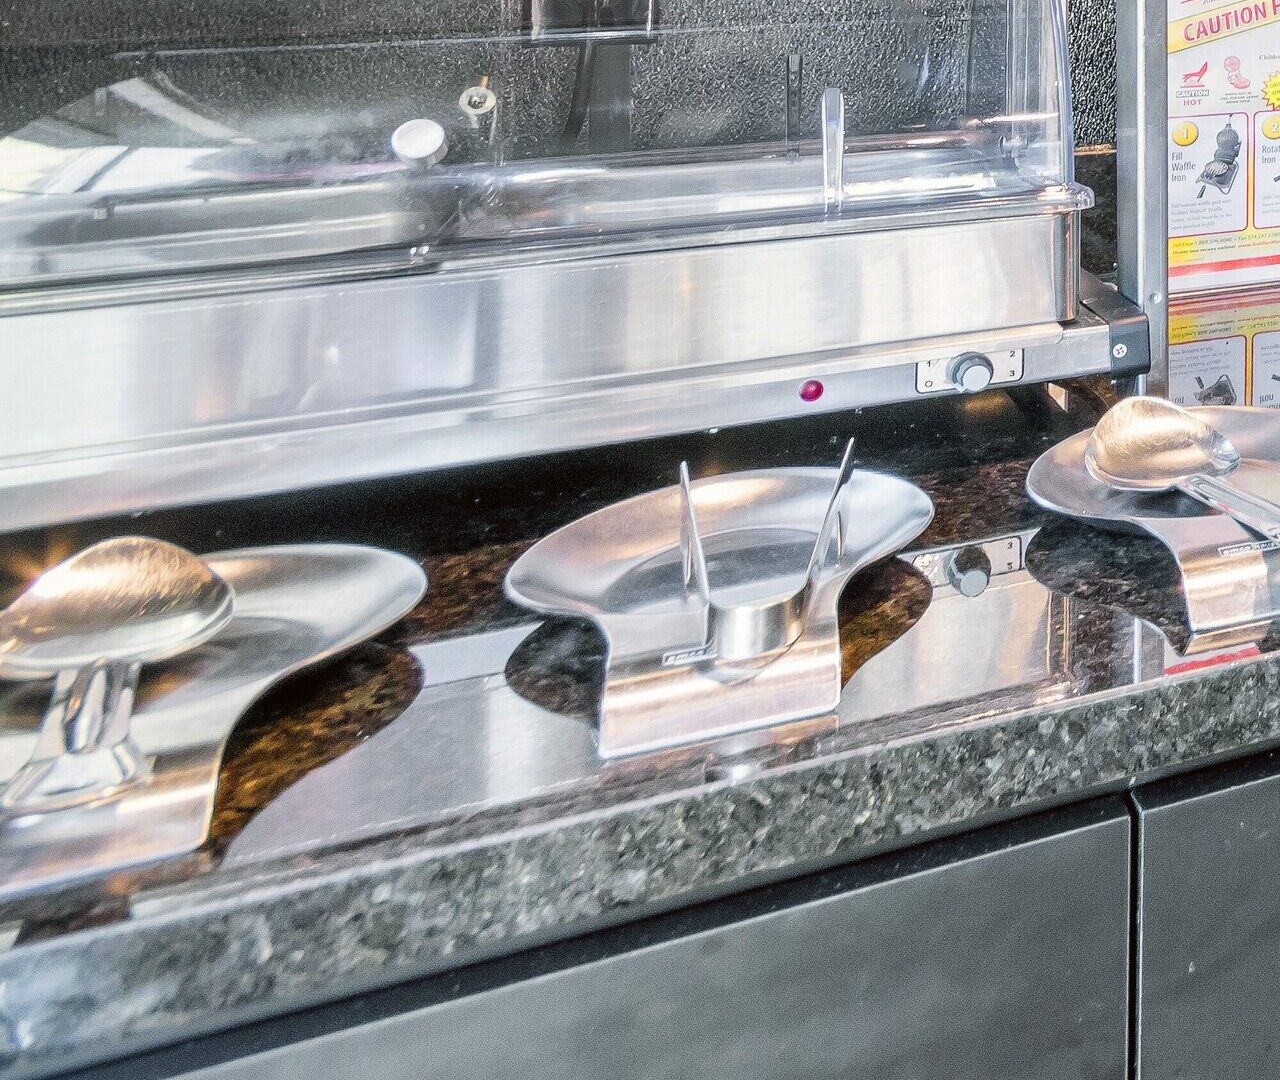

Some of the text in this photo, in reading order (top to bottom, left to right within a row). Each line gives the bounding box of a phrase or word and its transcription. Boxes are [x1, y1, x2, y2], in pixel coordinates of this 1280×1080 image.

[1184, 2, 1267, 41] CAUTION
[1171, 151, 1183, 161] Fill
[1262, 155, 1276, 164] Iron
[1171, 161, 1196, 171] Waffle
[1171, 173, 1187, 182] Iron
